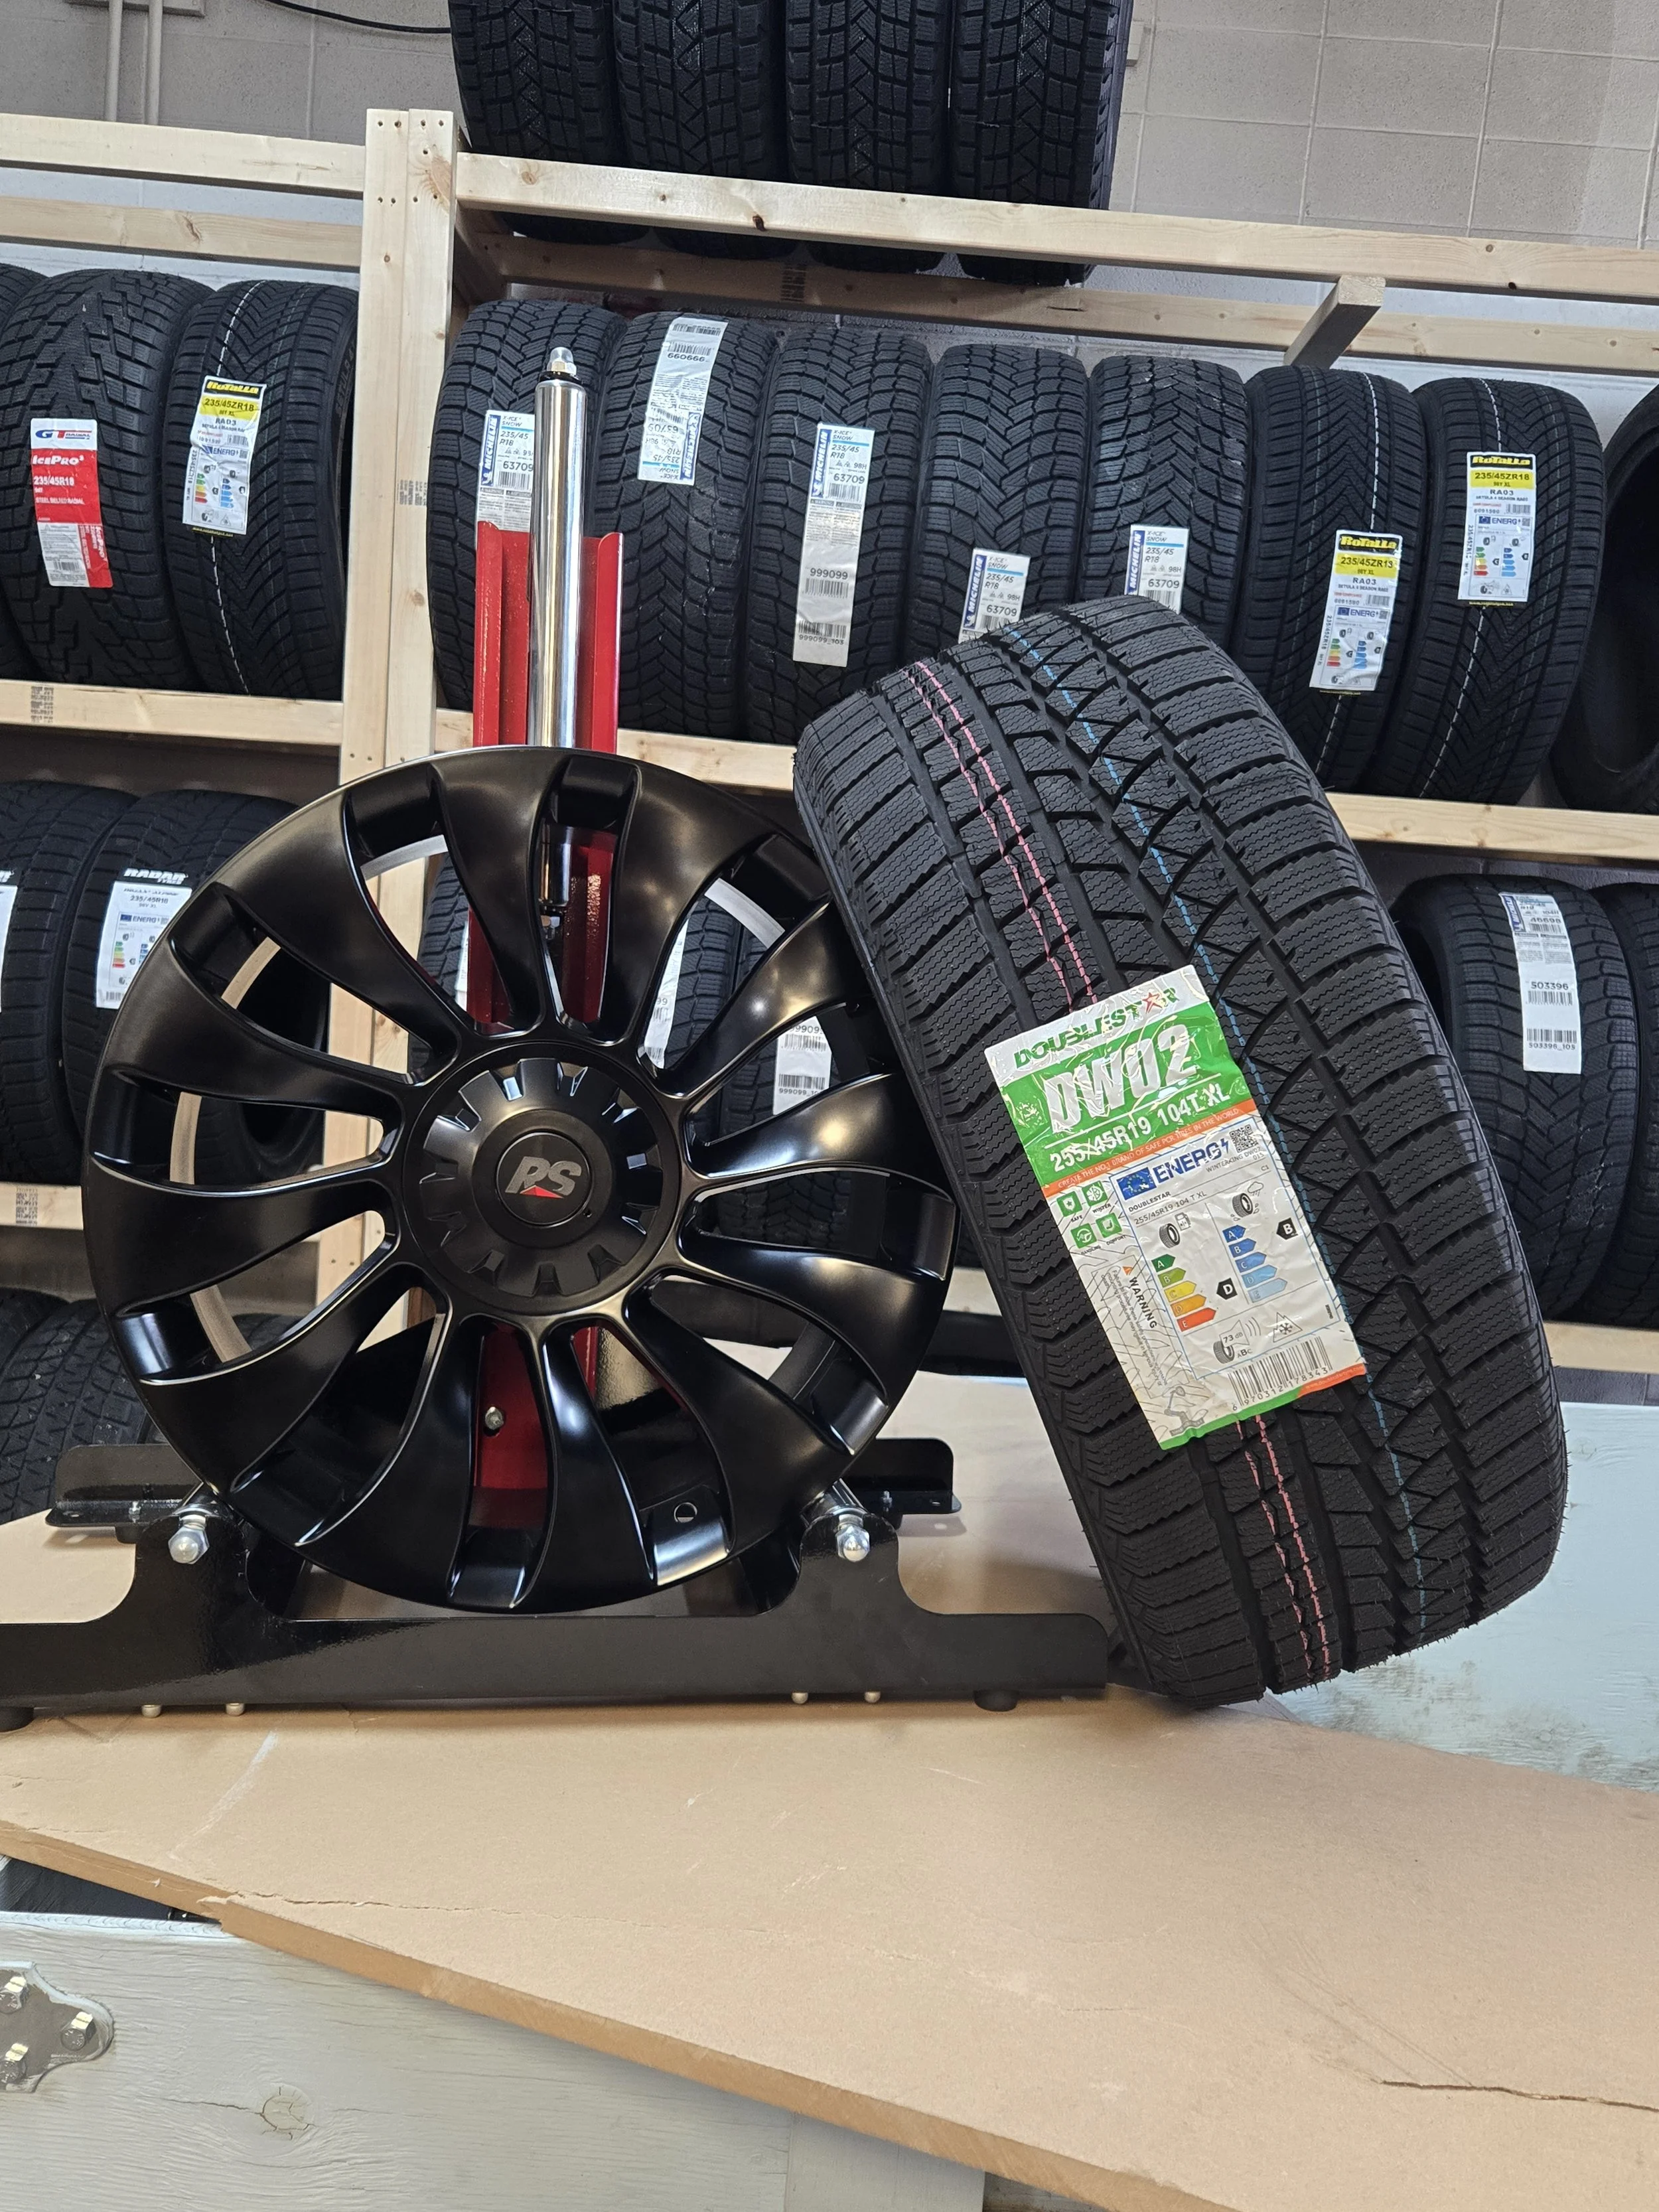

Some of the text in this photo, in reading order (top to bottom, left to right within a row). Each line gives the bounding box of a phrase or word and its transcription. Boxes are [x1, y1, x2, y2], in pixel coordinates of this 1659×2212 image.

[204, 398, 254, 411] 235/45ZR18
[500, 431, 528, 440] 235/45
[484, 417, 498, 469] MICHELIN
[831, 444, 860, 453] 235/45
[815, 431, 828, 482] MICHELIN
[503, 461, 534, 472] 63709
[33, 475, 75, 487] 235/45R18
[833, 473, 865, 484] 63709
[1475, 472, 1530, 480] 235/45ZR18
[1145, 548, 1175, 556] 235/45
[1129, 532, 1141, 589] MICHELIN
[810, 567, 848, 580] 999099
[986, 573, 1014, 583] 235/45
[968, 557, 983, 613] MICHELIN
[1148, 579, 1180, 589] 63709
[986, 605, 1017, 617] 63709
[123, 868, 186, 879] RADAR
[1531, 982, 1569, 990] 503396
[1042, 1024, 1202, 1134] DW02
[1049, 1082, 1231, 1173] 255/45R19 104T XL
[1057, 1174, 1081, 1189] CREATE
[1081, 1167, 1096, 1178] THE
[1111, 1151, 1135, 1166] BRAND
[1134, 1147, 1145, 1156] OF
[1144, 1140, 1161, 1152] SAFE
[1161, 1135, 1175, 1145] PCR
[1201, 1118, 1215, 1128] THE
[1214, 1108, 1240, 1122] WORLD
[1155, 1143, 1223, 1184] ENERG
[1206, 1146, 1262, 1173] WINTERKING DW02
[505, 1156, 582, 1195] RS
[1127, 1191, 1171, 1213] DOUBLESTAR
[1133, 1202, 1175, 1225] 255/45R19
[1174, 1196, 1190, 1208] 104
[1195, 1189, 1207, 1199] XL
[1226, 1229, 1235, 1238] A
[1282, 1222, 1293, 1234] B
[1234, 1245, 1241, 1254] B
[1155, 1259, 1165, 1268] A
[1163, 1275, 1171, 1284] B
[1222, 1282, 1234, 1294] D
[1169, 1290, 1177, 1299] C
[1129, 1276, 1157, 1329] WARNING
[1175, 1304, 1183, 1313] D
[1222, 1334, 1234, 1343] 73
[1243, 1385, 1284, 1406] 970312
[1287, 1366, 1329, 1388] 178343
